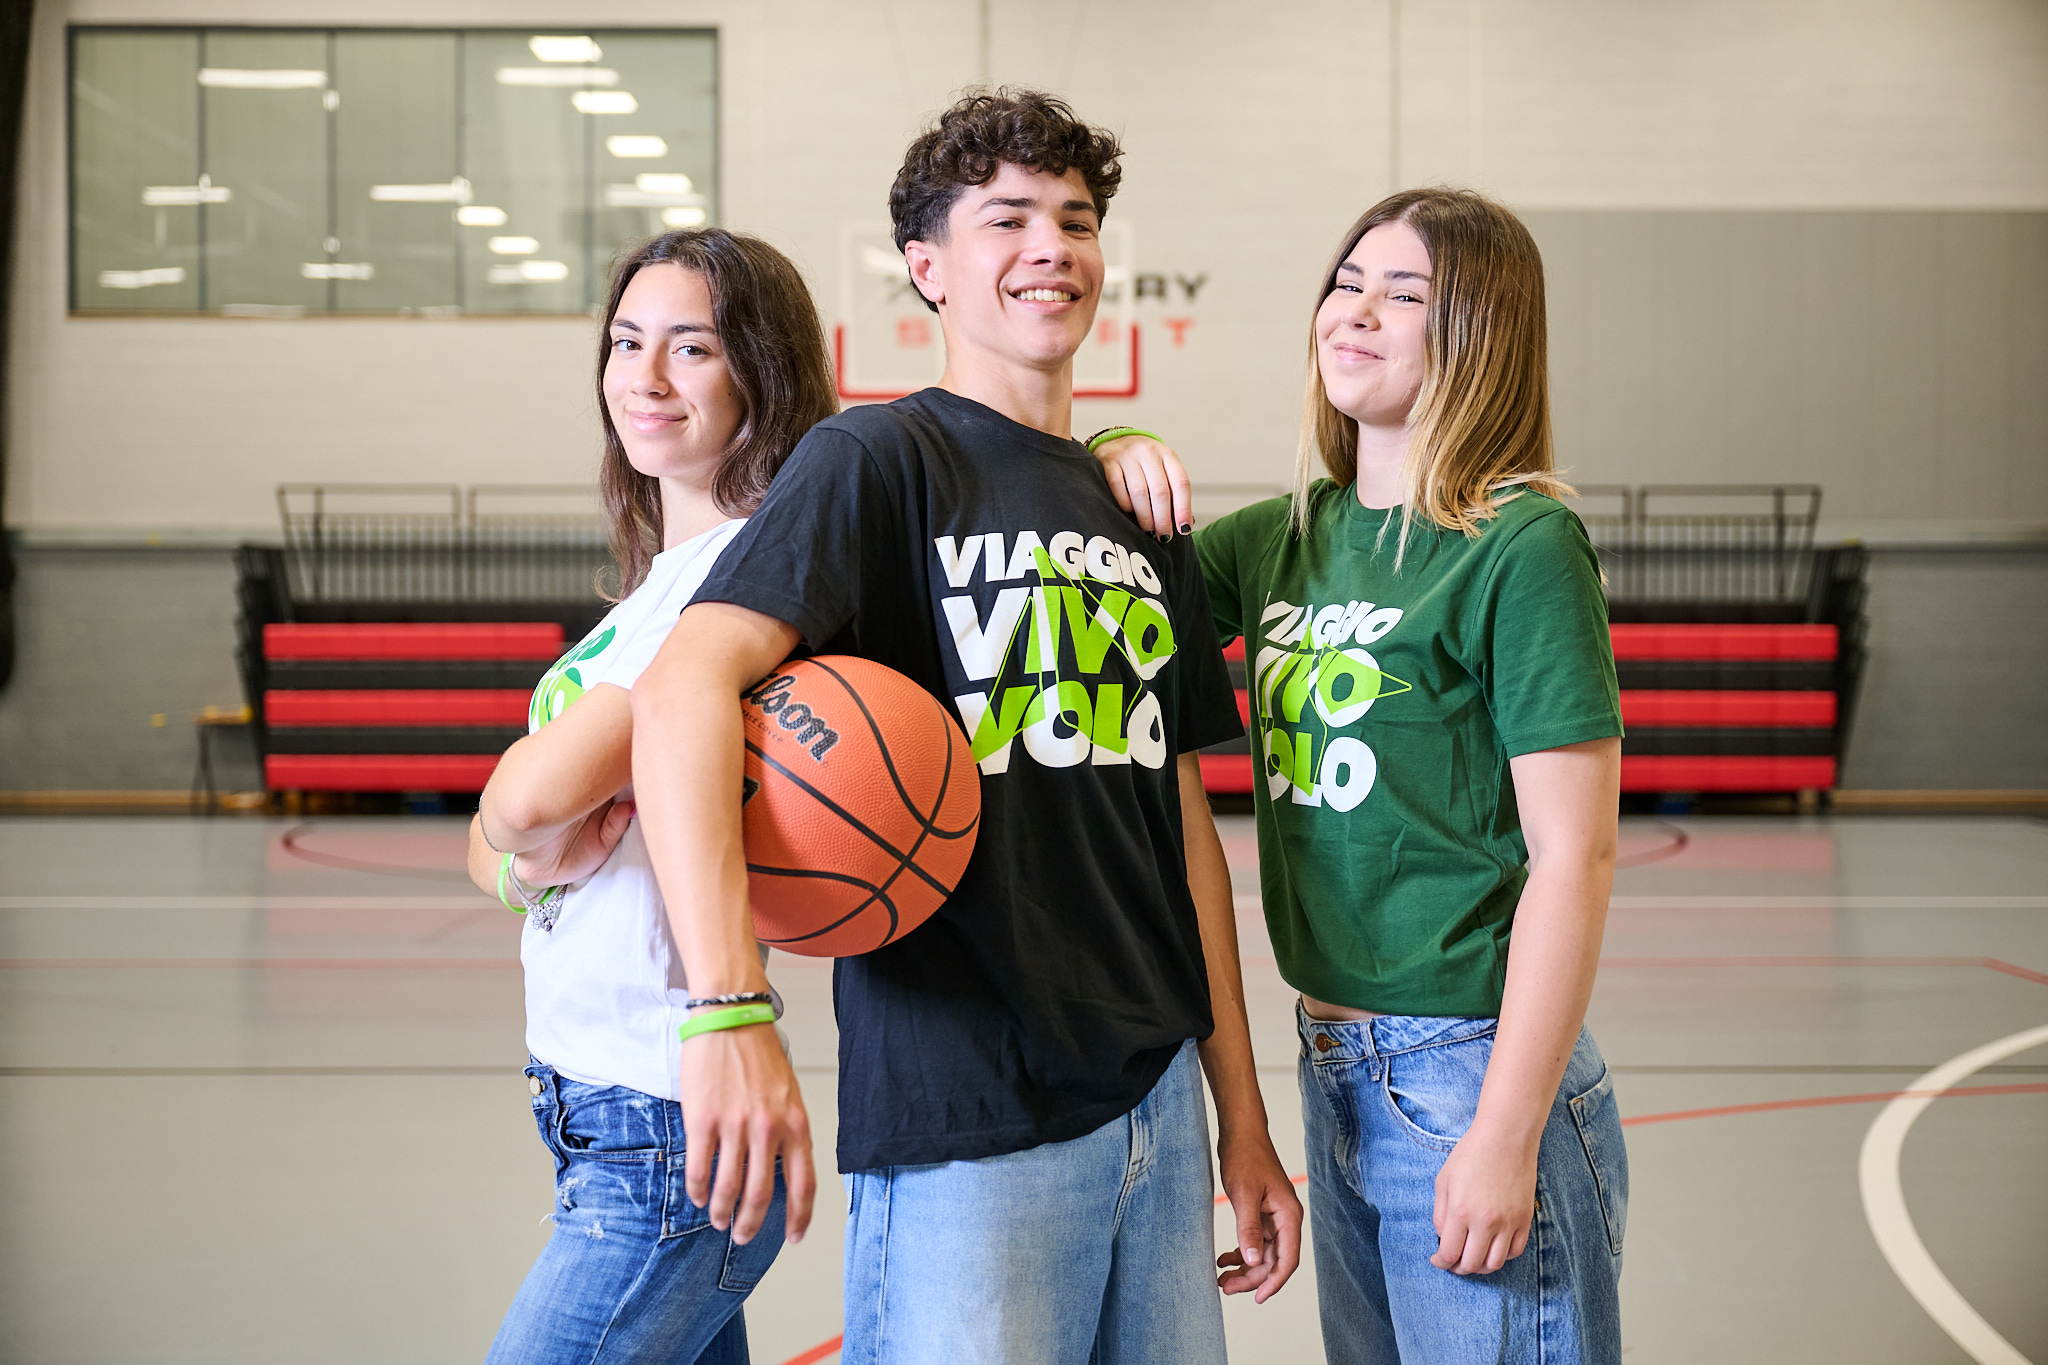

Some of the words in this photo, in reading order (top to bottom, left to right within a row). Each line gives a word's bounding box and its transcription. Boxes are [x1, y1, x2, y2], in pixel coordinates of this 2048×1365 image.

[934, 530, 1162, 595] VIAGGIO
[941, 586, 1175, 682] VIVO
[739, 671, 841, 763] ilson
[954, 680, 1167, 776] VOLO
[1261, 727, 1378, 813] OLO
